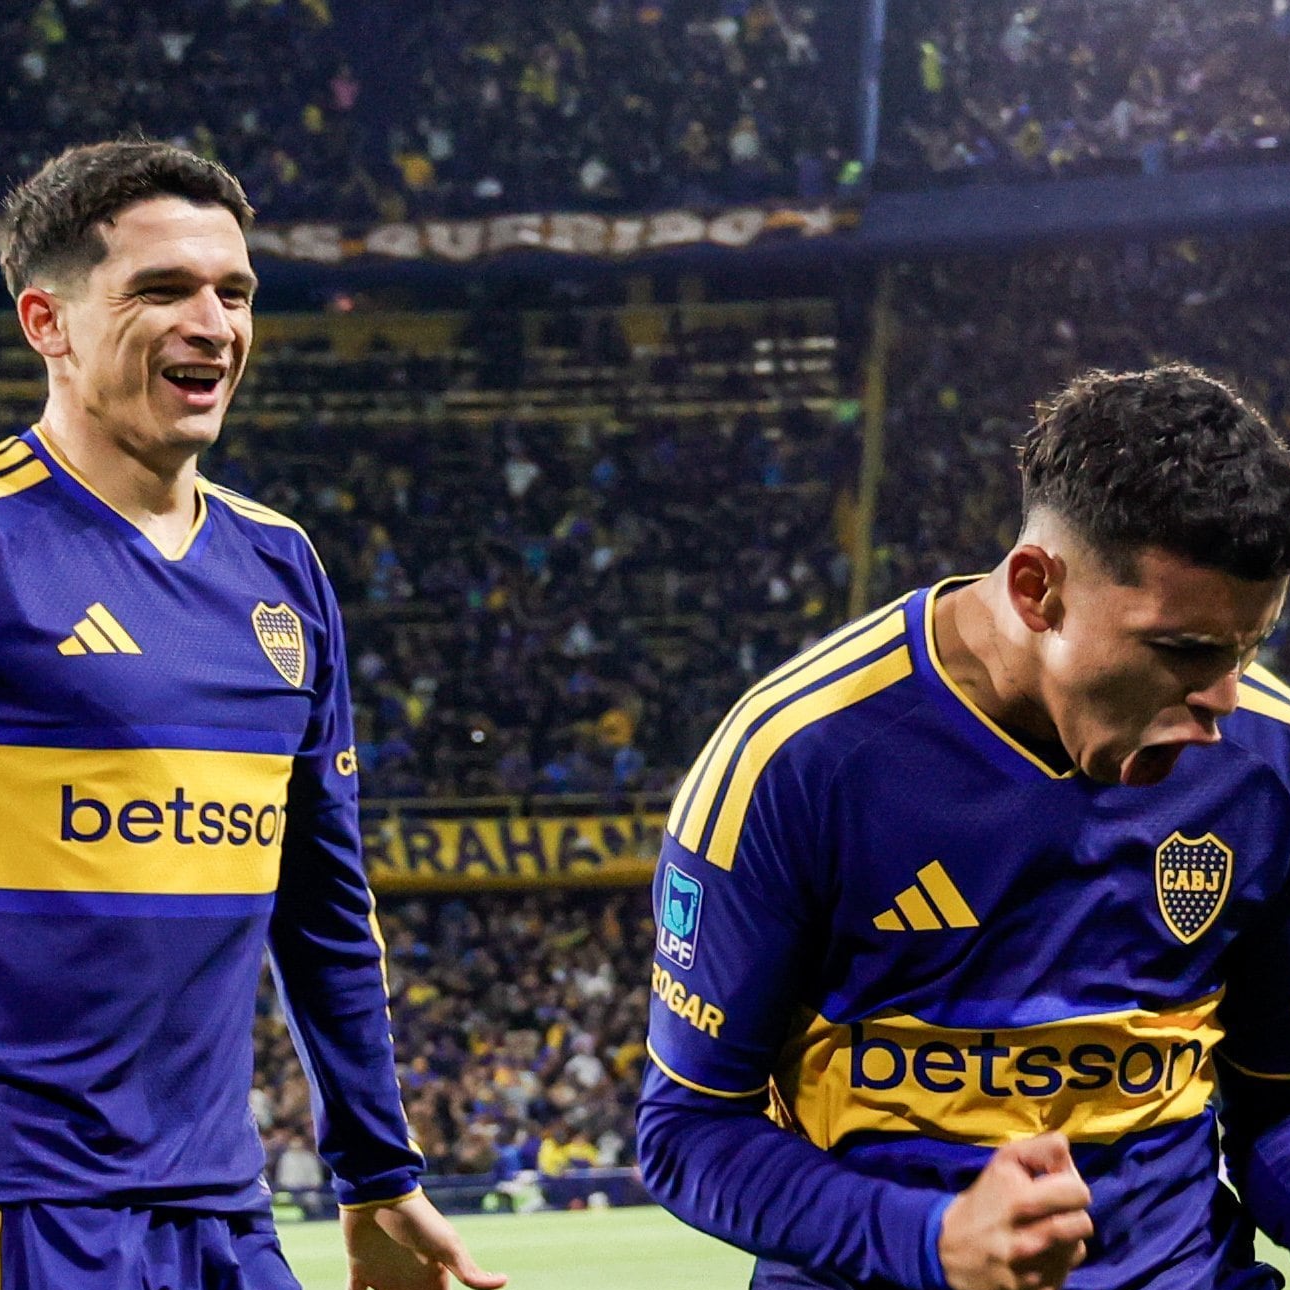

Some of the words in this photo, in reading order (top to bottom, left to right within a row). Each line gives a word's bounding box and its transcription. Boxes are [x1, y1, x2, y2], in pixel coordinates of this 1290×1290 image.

[1163, 869, 1221, 892] CABJ
[659, 925, 693, 963] LPF
[849, 1022, 1203, 1098] betsson
